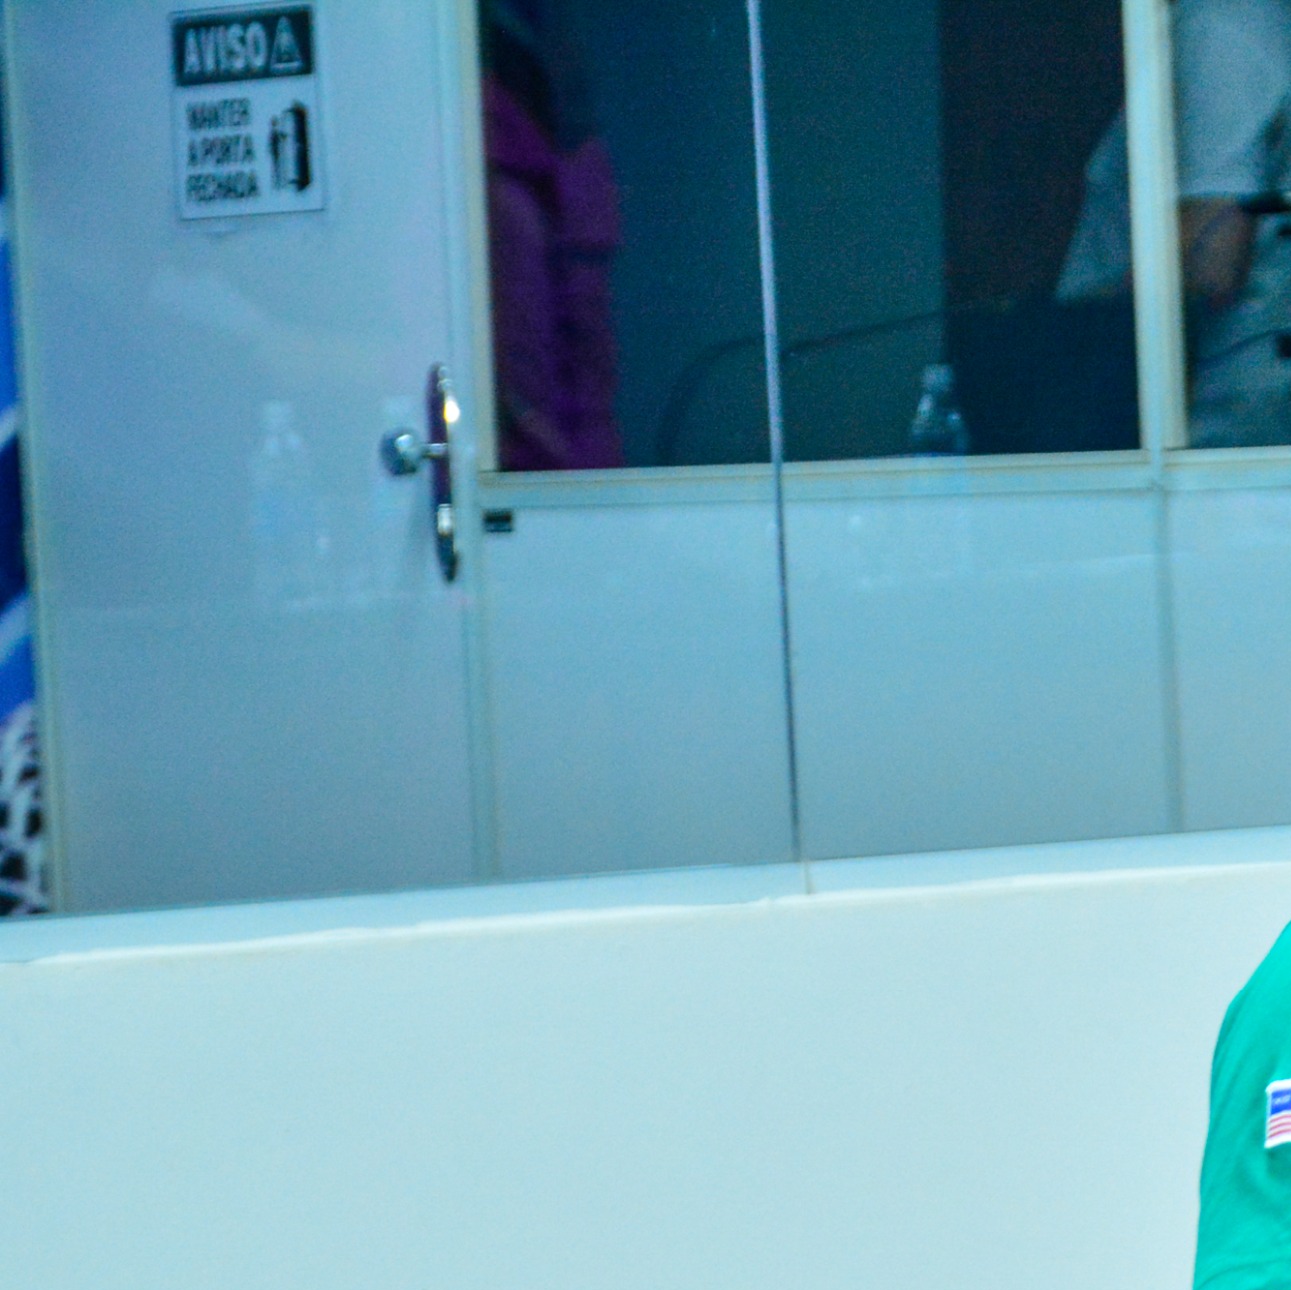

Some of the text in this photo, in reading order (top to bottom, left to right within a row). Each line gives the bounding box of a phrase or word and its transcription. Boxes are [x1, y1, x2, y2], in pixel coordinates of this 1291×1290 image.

[184, 20, 268, 74] AVISO
[187, 98, 250, 130] MANTER
[188, 134, 254, 166] A PORTA
[186, 170, 260, 202] FECHADA
